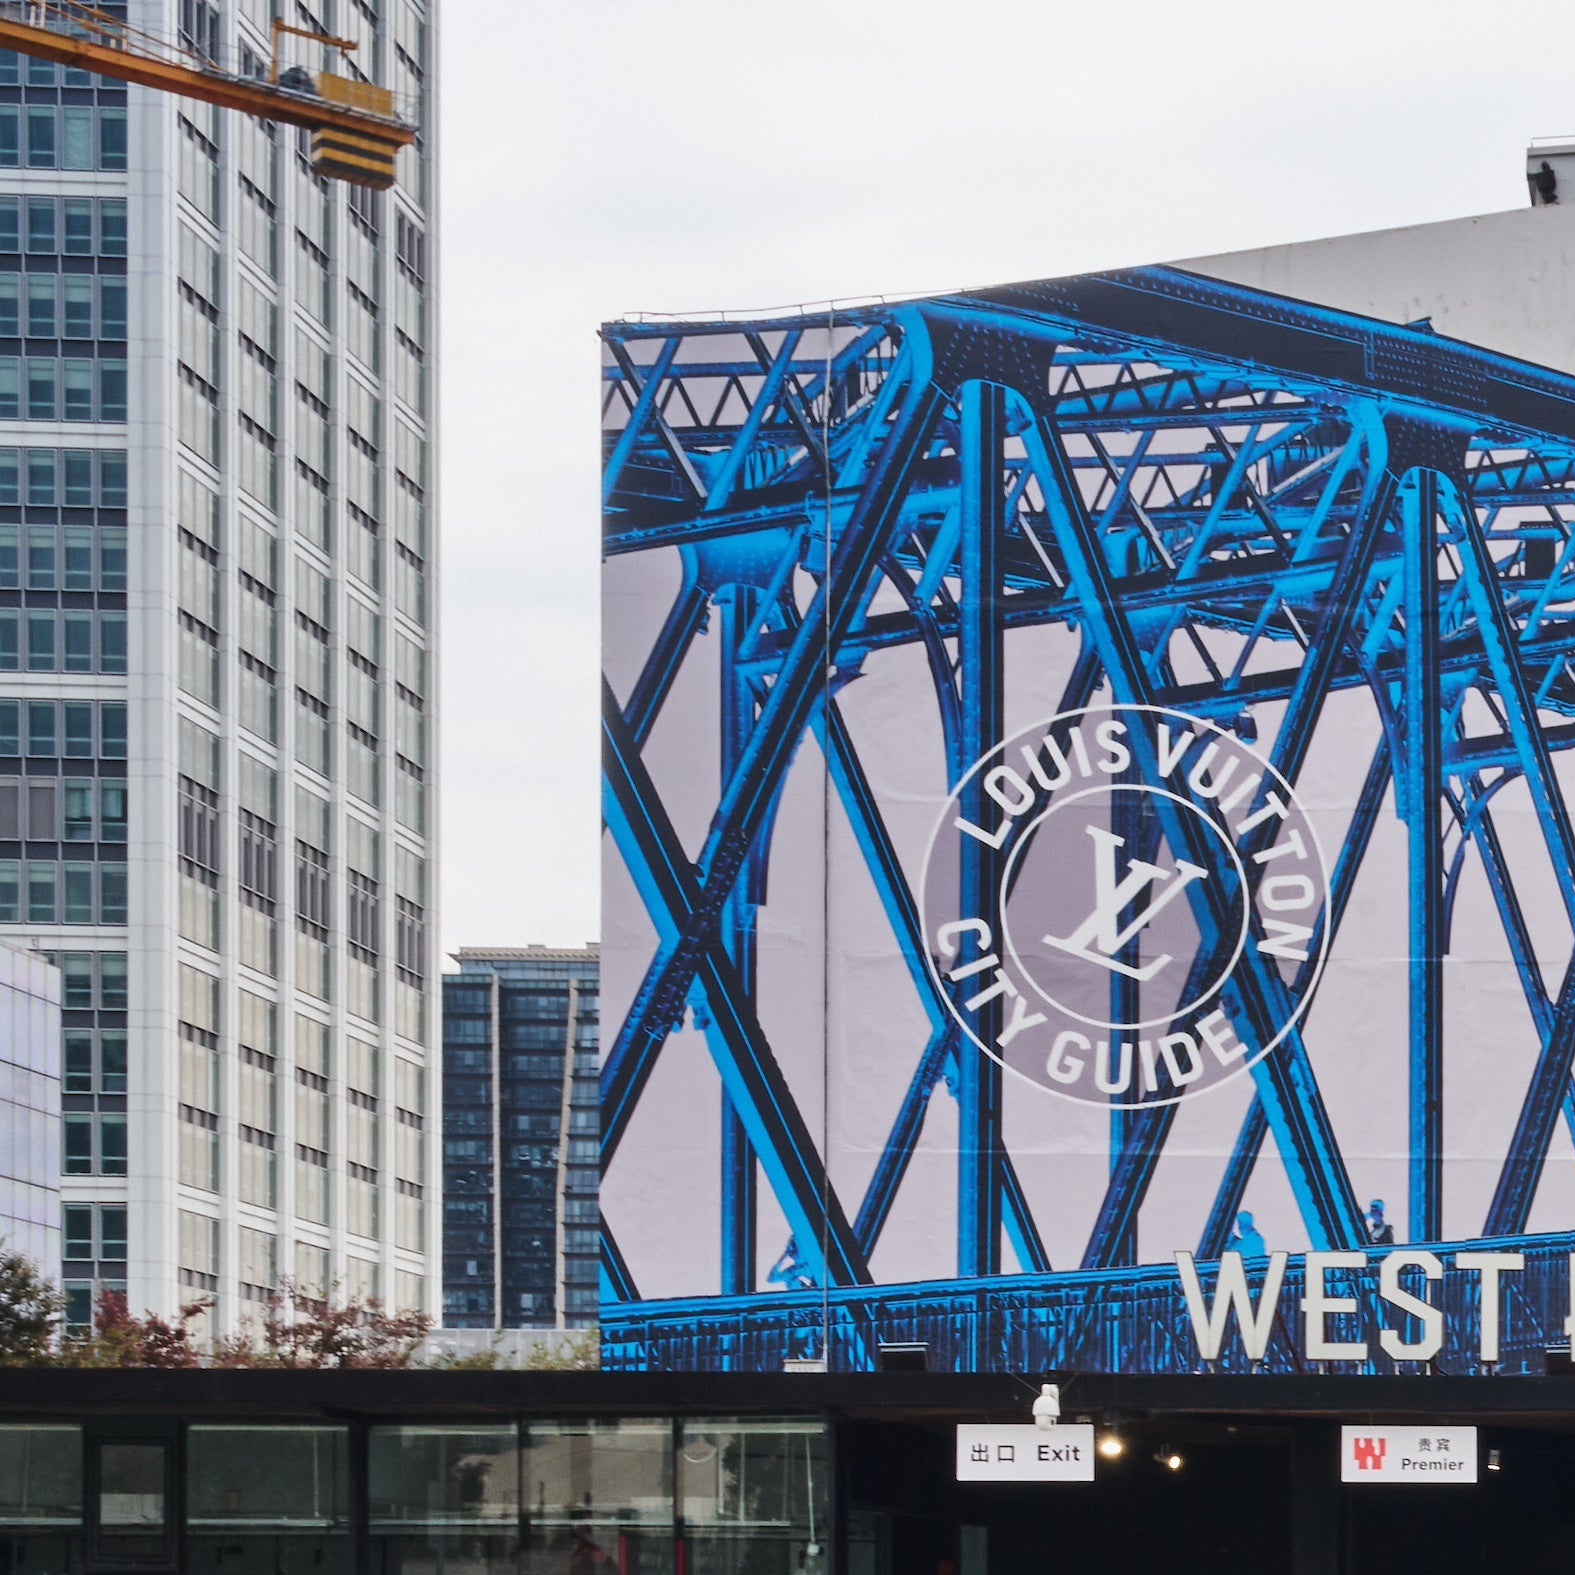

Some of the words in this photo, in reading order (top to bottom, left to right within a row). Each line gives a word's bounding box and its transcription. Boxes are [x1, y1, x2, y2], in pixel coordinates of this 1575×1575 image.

[953, 720, 1131, 850] LOUIS
[1155, 722, 1316, 963] VUITTON
[936, 917, 1048, 1048] CITY
[1045, 1008, 1249, 1095] GUIDE
[1173, 1250, 1525, 1361] WEST
[971, 1443, 1014, 1462] 出口
[1037, 1445, 1080, 1462] Exit
[1401, 1458, 1464, 1470] Premier
[1418, 1438, 1450, 1452] 贵宾
